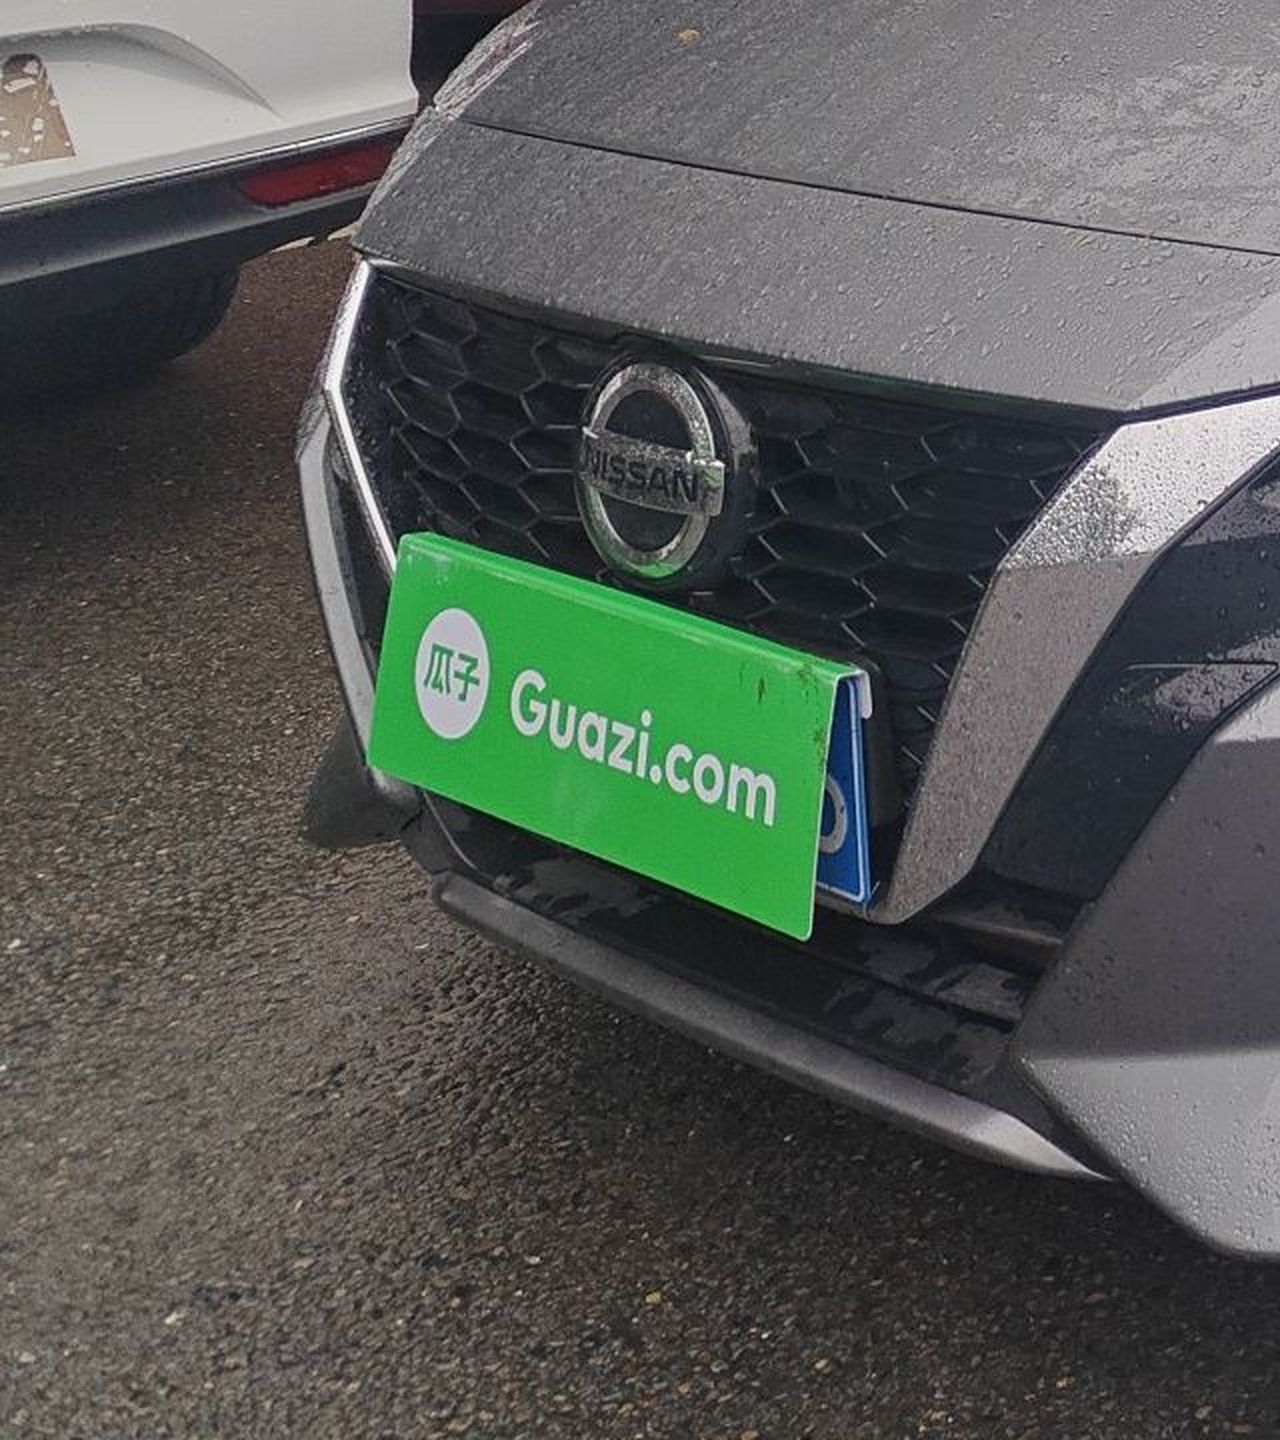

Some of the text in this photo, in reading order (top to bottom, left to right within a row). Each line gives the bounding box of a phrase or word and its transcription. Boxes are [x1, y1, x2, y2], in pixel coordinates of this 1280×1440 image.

[588, 448, 697, 502] NISSAN
[424, 643, 480, 702] 瓜子
[511, 669, 776, 828] Guazi.com
